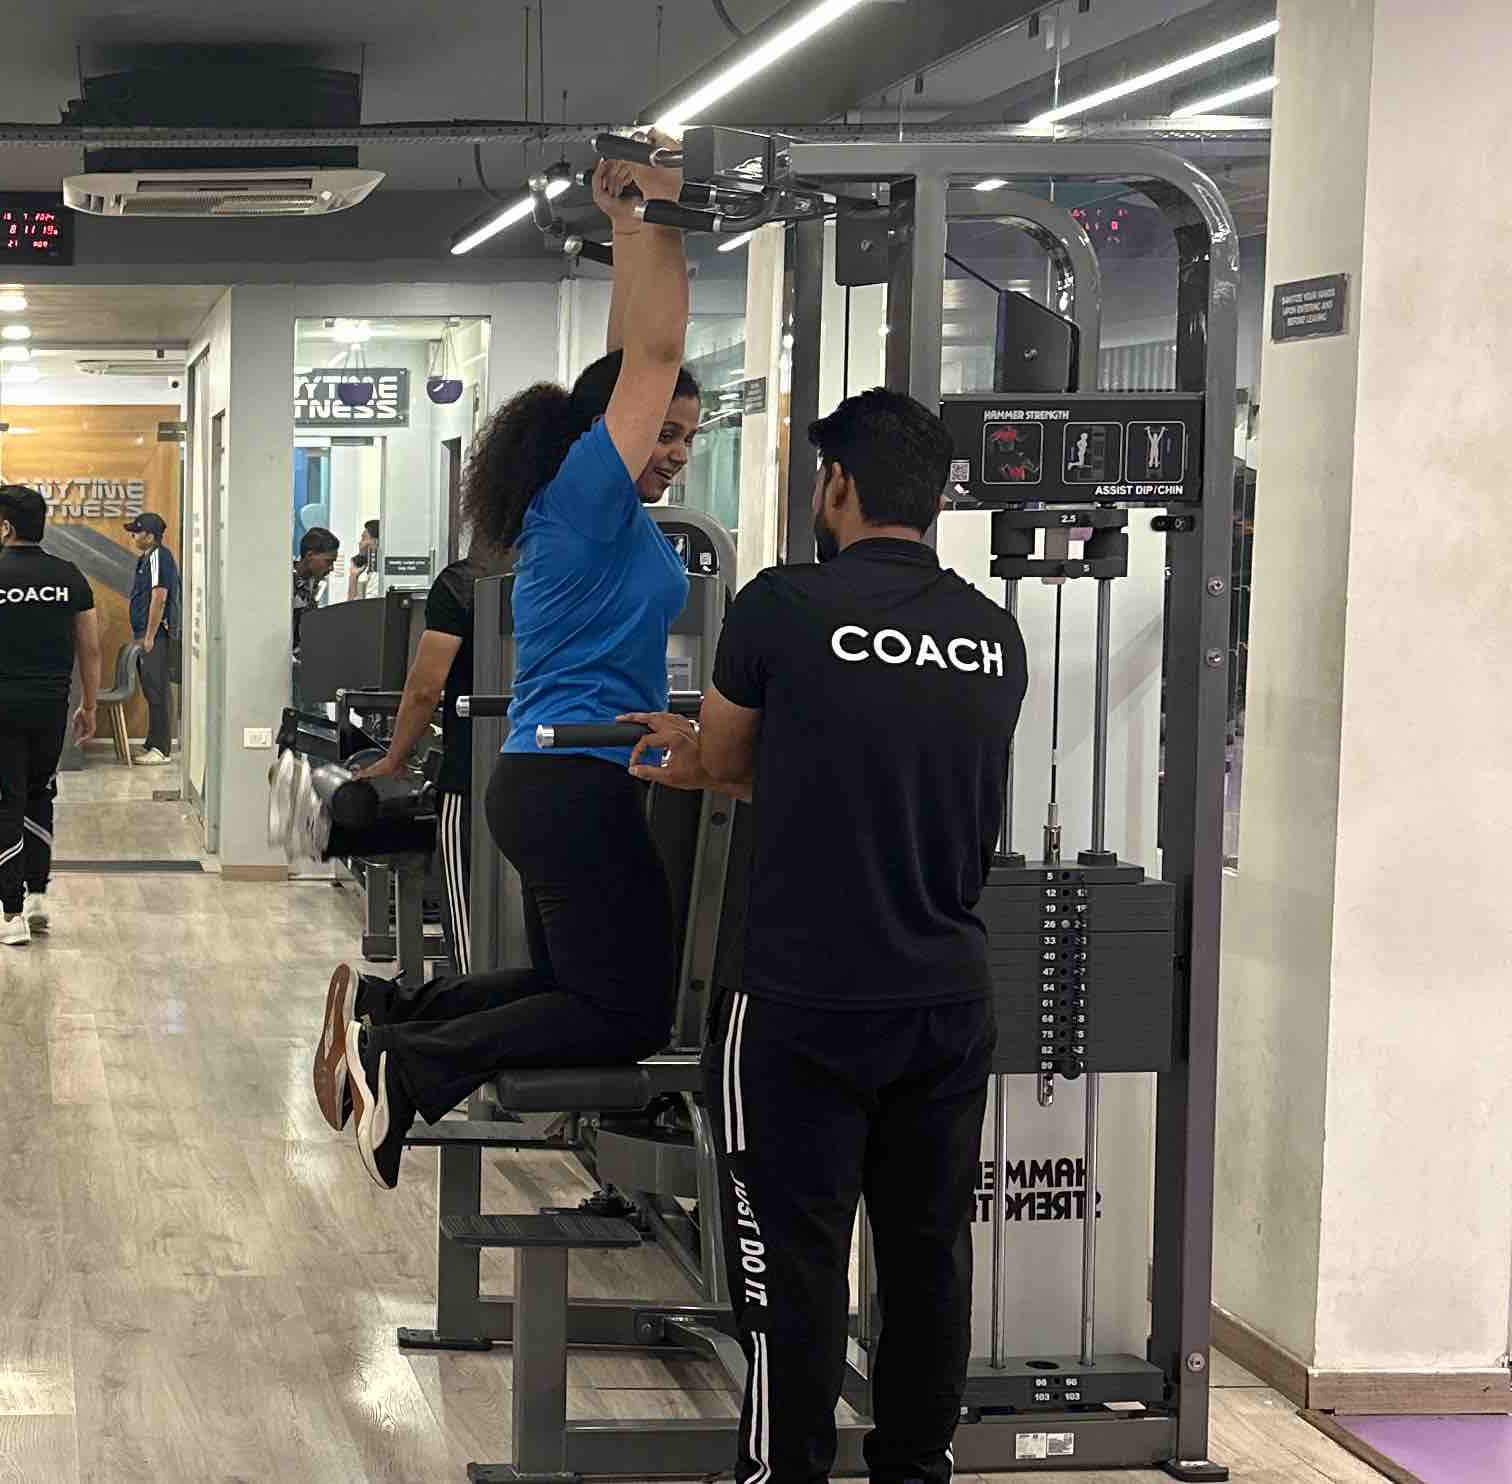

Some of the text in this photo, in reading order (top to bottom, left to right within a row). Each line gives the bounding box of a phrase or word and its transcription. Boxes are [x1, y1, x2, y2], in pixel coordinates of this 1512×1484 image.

[983, 410, 1070, 421] HAMMER STRENGTH
[28, 479, 145, 499] NYTIME
[1095, 485, 1184, 496] ASSIST DIP/CHIN
[1060, 514, 1076, 523] 2.5
[831, 625, 1004, 677] COACH
[1047, 872, 1054, 880] 5
[1045, 888, 1057, 897] 12
[1045, 904, 1057, 912] 19
[1044, 936, 1056, 944] 33
[1043, 952, 1056, 960] 40
[1042, 967, 1055, 976] 47
[1042, 983, 1055, 991] 54
[1042, 999, 1054, 1008] 61
[1041, 1030, 1054, 1039] 75
[729, 1169, 761, 1236] JUST
[740, 1238, 767, 1273] DO
[1034, 1392, 1050, 1401] 103
[1065, 1392, 1080, 1401] 103
